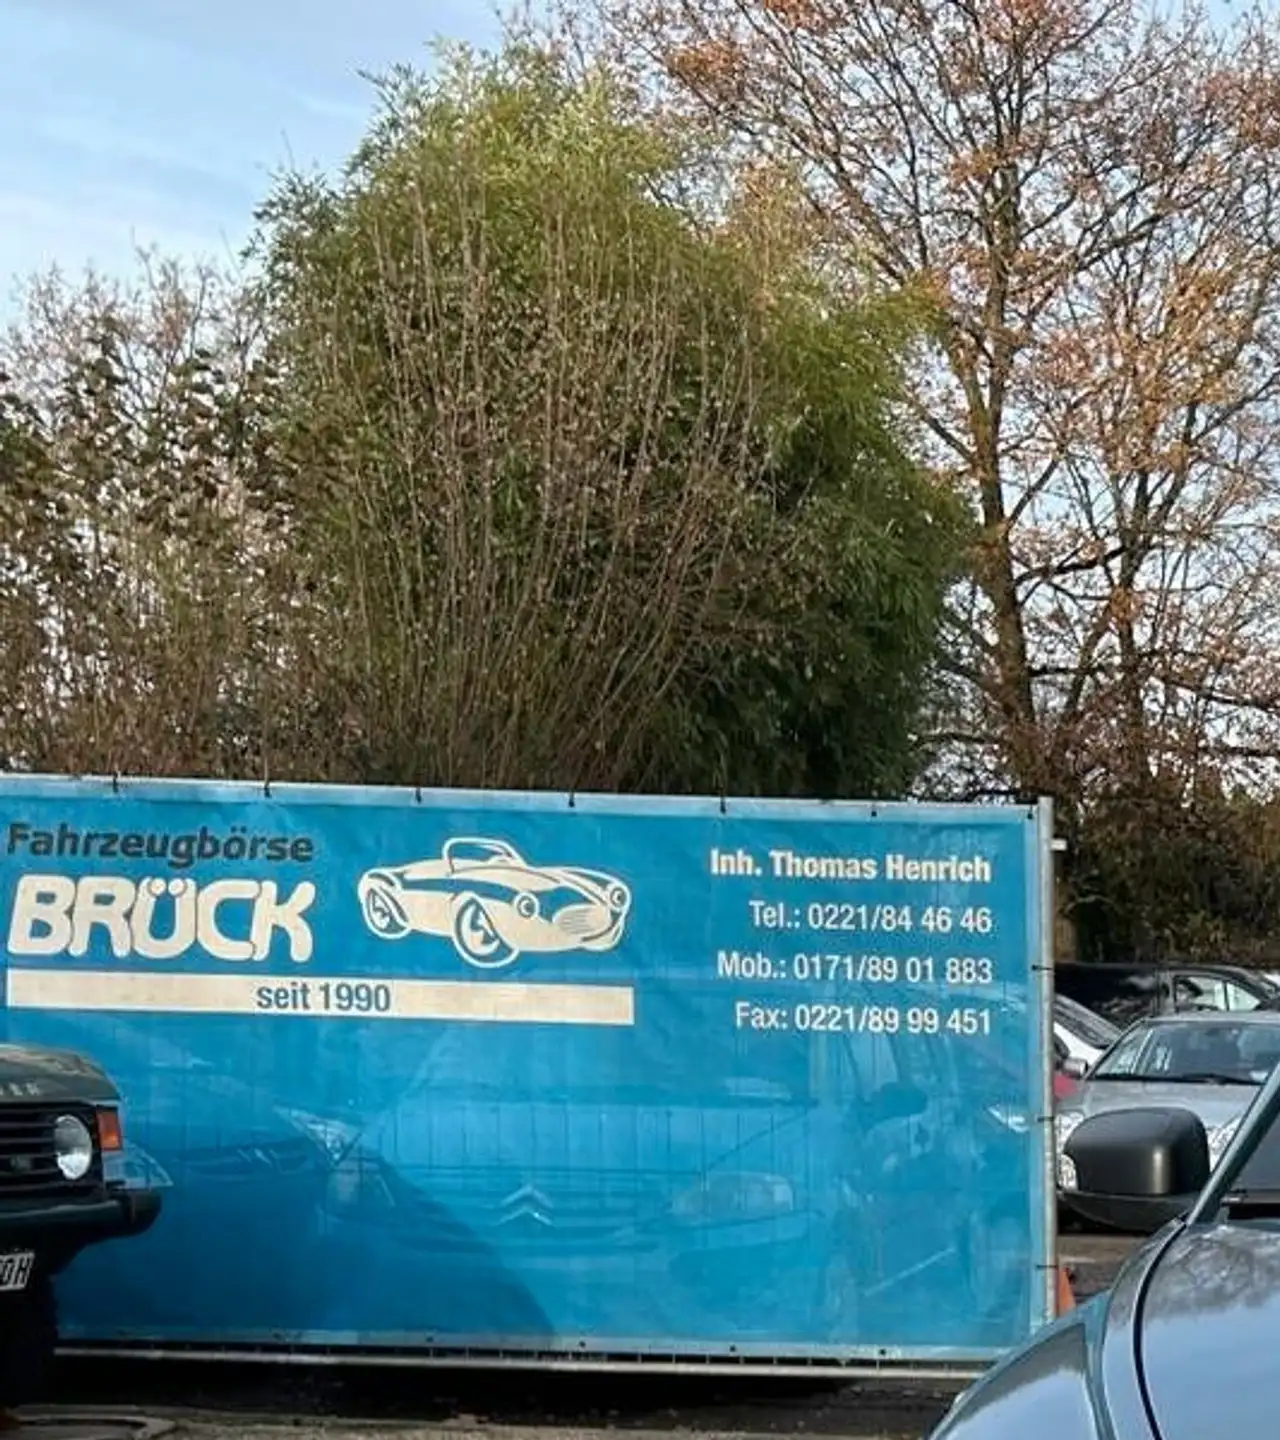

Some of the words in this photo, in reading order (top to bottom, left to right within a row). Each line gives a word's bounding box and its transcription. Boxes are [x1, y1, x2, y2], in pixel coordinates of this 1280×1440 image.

[7, 822, 315, 868] Fahrzeugbörse
[710, 848, 763, 877] Inh.
[769, 850, 877, 880] Thomas
[885, 854, 991, 883] Henrich
[7, 875, 316, 961] BRÜCK
[749, 900, 800, 929] Tel.:
[807, 902, 912, 931] 0221/84
[921, 906, 952, 933] 46
[960, 907, 992, 934] 46
[717, 951, 786, 979] Mob.:
[794, 953, 897, 983] 0171/89
[906, 956, 934, 983] 01
[946, 957, 992, 984] 883
[256, 983, 311, 1010] seit
[321, 983, 390, 1013] 1990
[735, 1001, 788, 1030] Fax:
[794, 1004, 900, 1033] 0221/89
[907, 1007, 939, 1034] 99
[946, 1008, 991, 1035] 451
